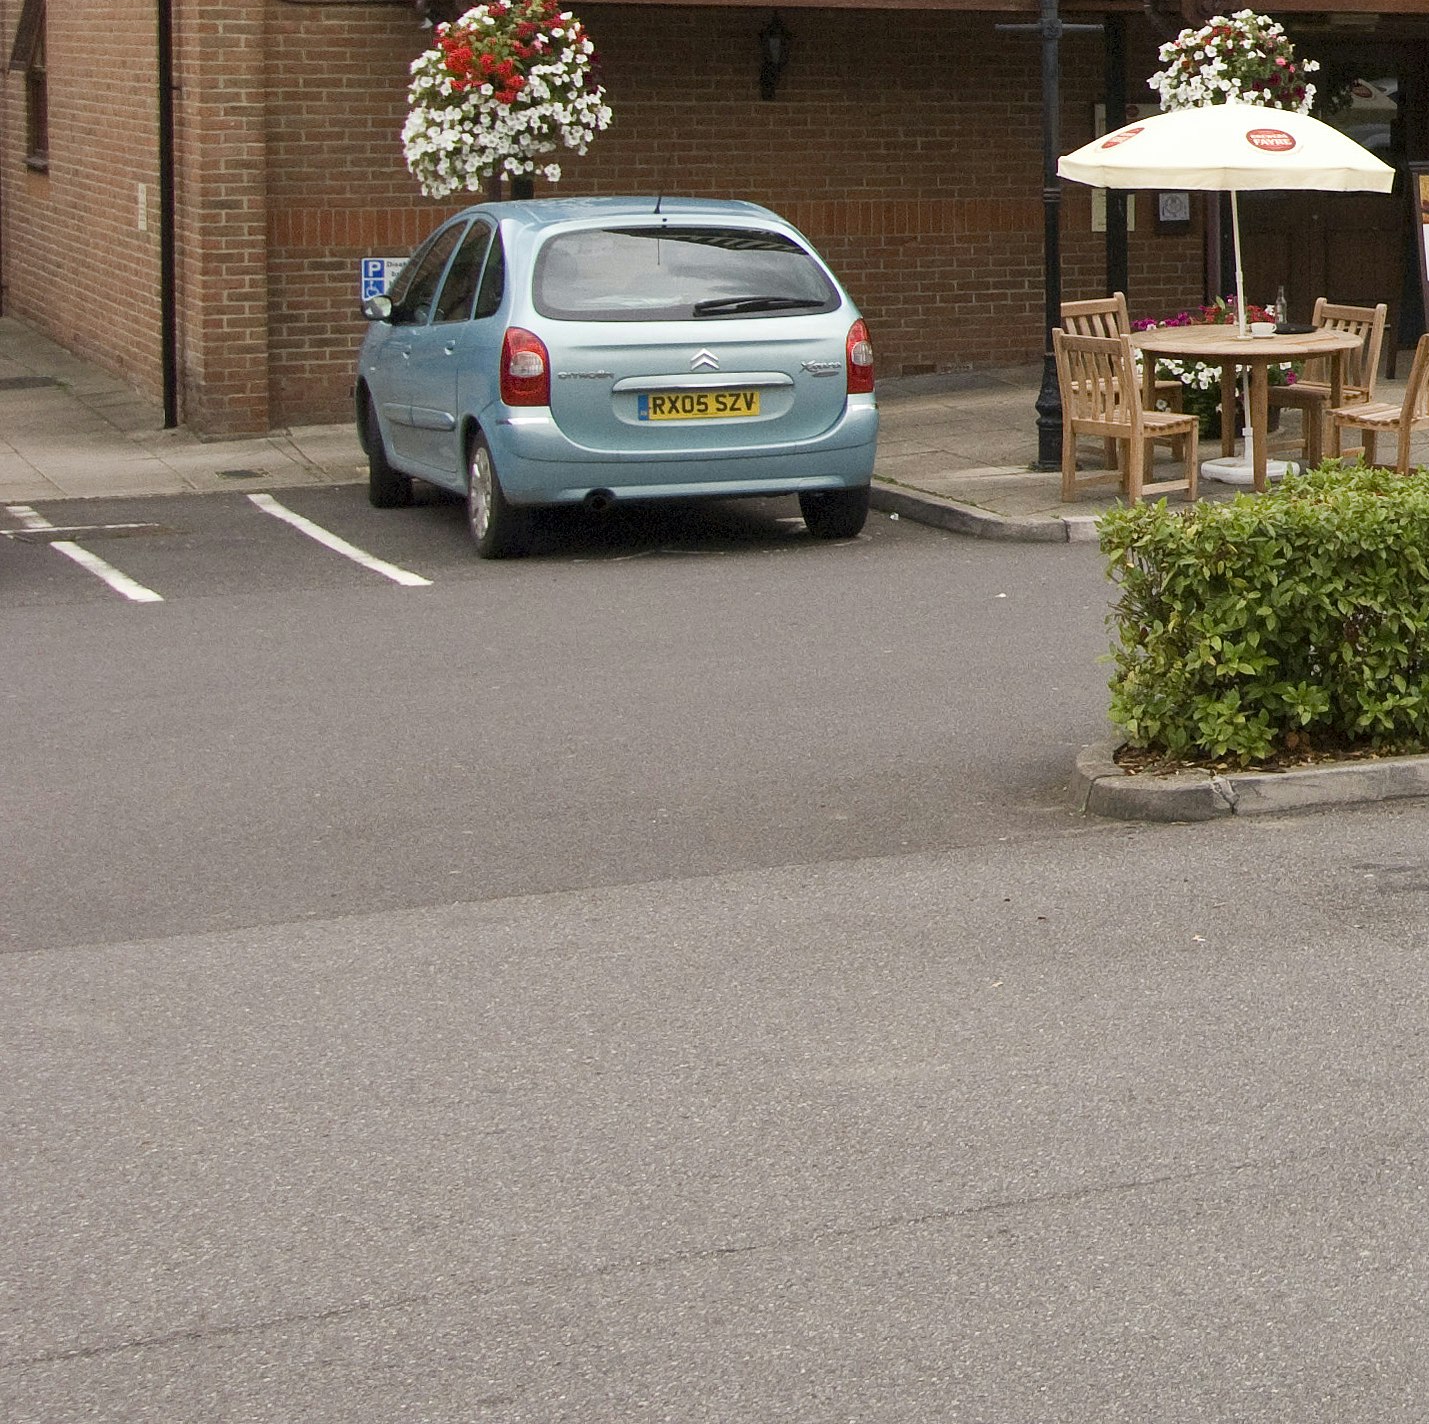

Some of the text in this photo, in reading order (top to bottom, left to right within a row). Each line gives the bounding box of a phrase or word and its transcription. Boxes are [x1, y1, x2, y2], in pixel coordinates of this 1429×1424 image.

[368, 261, 382, 277] P
[652, 393, 755, 415] RX05 SZV
